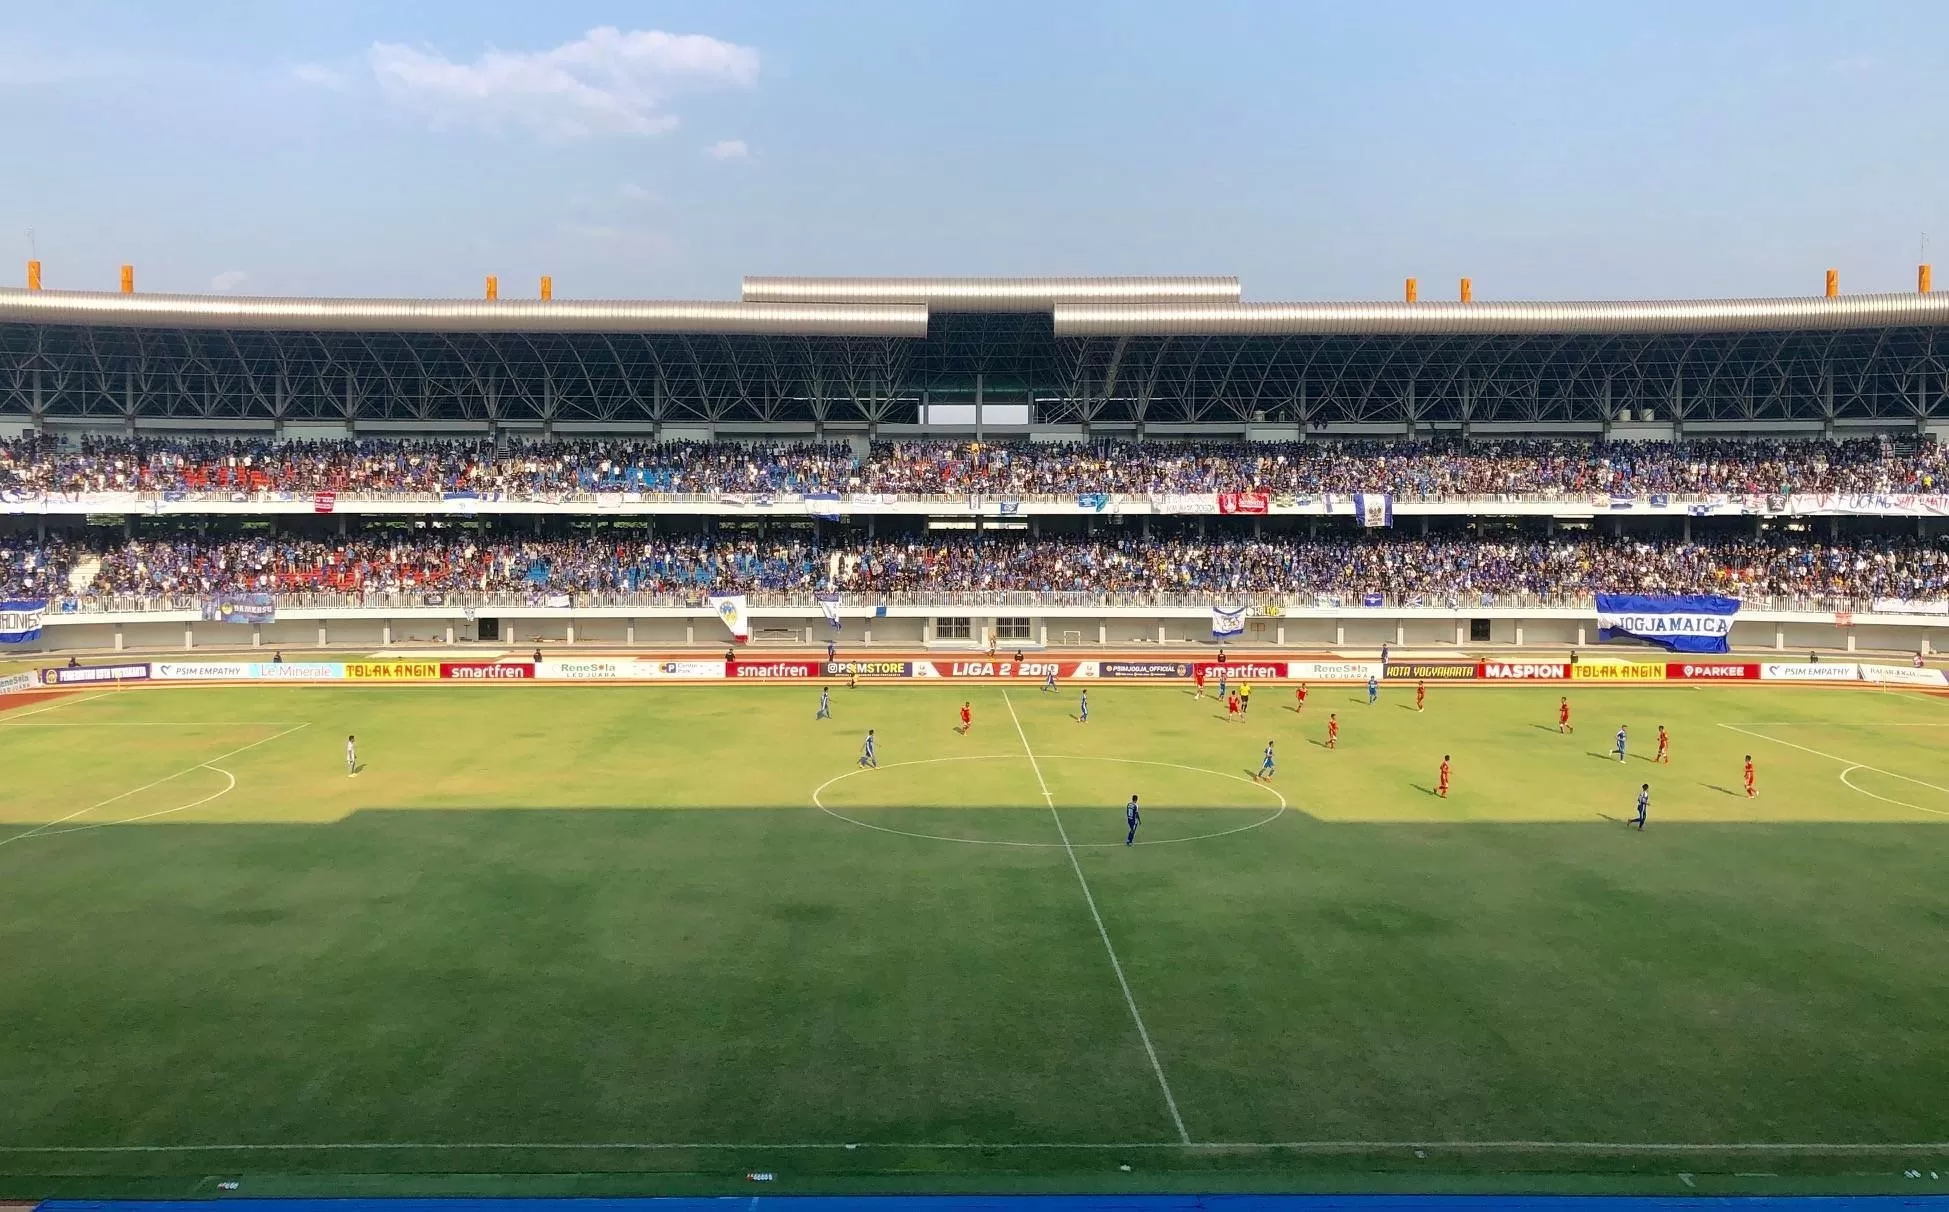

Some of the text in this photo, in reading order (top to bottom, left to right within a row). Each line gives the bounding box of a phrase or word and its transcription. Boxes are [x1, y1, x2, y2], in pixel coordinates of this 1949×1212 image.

[1619, 616, 1729, 633] JOGJAMAICA
[175, 667, 241, 675] PSIM EMPATHY
[261, 664, 332, 677] Le Minerale
[346, 664, 436, 677] TOLAK ANGIN
[451, 665, 524, 679] smartfren
[737, 663, 808, 677] smartfren
[952, 662, 1059, 676] LIGA 2 2019
[1205, 664, 1277, 678] smartfren
[1485, 664, 1564, 678] MASPION
[1575, 665, 1661, 678] TOLAK ANGIN
[1695, 666, 1744, 677] PARKEE
[1784, 667, 1849, 676] PSIM EMPATHY
